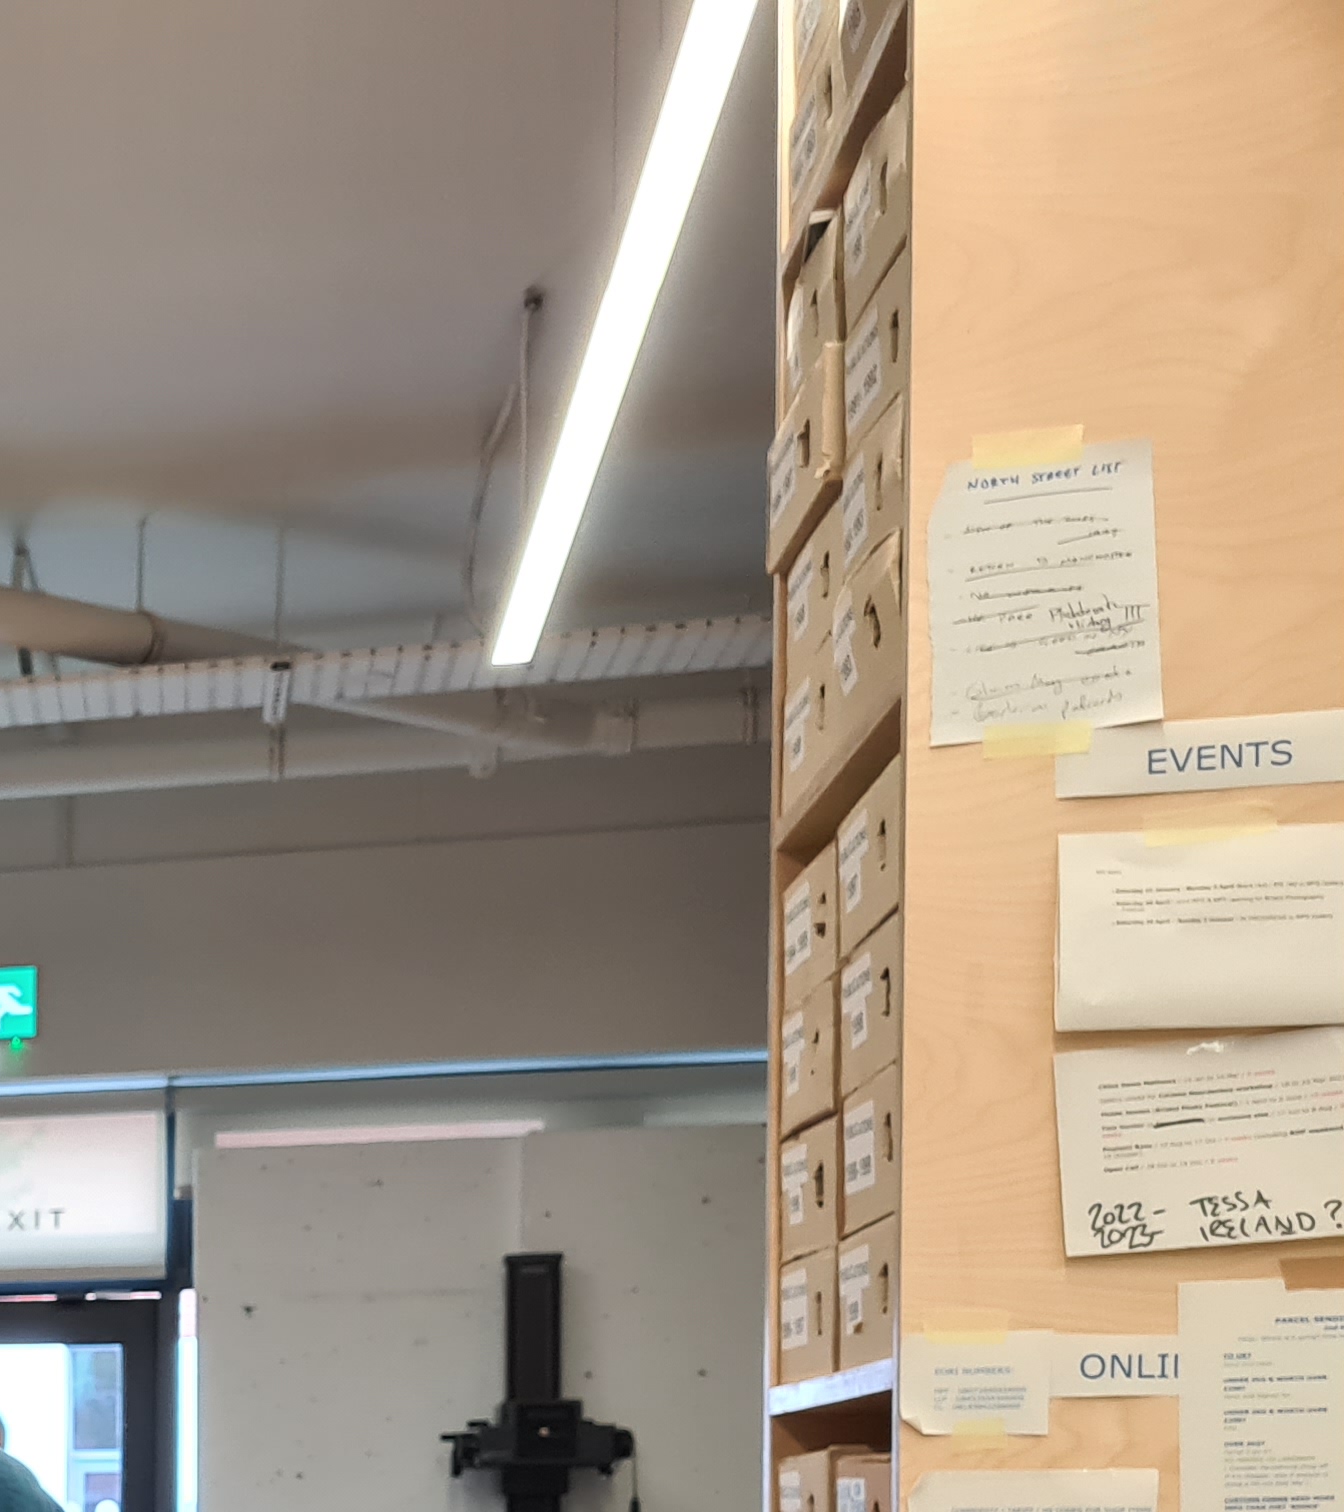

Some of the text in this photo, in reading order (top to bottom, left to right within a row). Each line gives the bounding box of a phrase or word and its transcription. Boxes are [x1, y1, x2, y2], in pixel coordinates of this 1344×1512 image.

[967, 461, 1124, 491] NORTH STREET LIST
[1146, 739, 1294, 777] EVENTS
[1088, 1202, 1144, 1231] 2022
[1189, 1190, 1272, 1218] TESSA
[1200, 1212, 1316, 1242] IRELAND
[1080, 1353, 1179, 1380] ONLI
